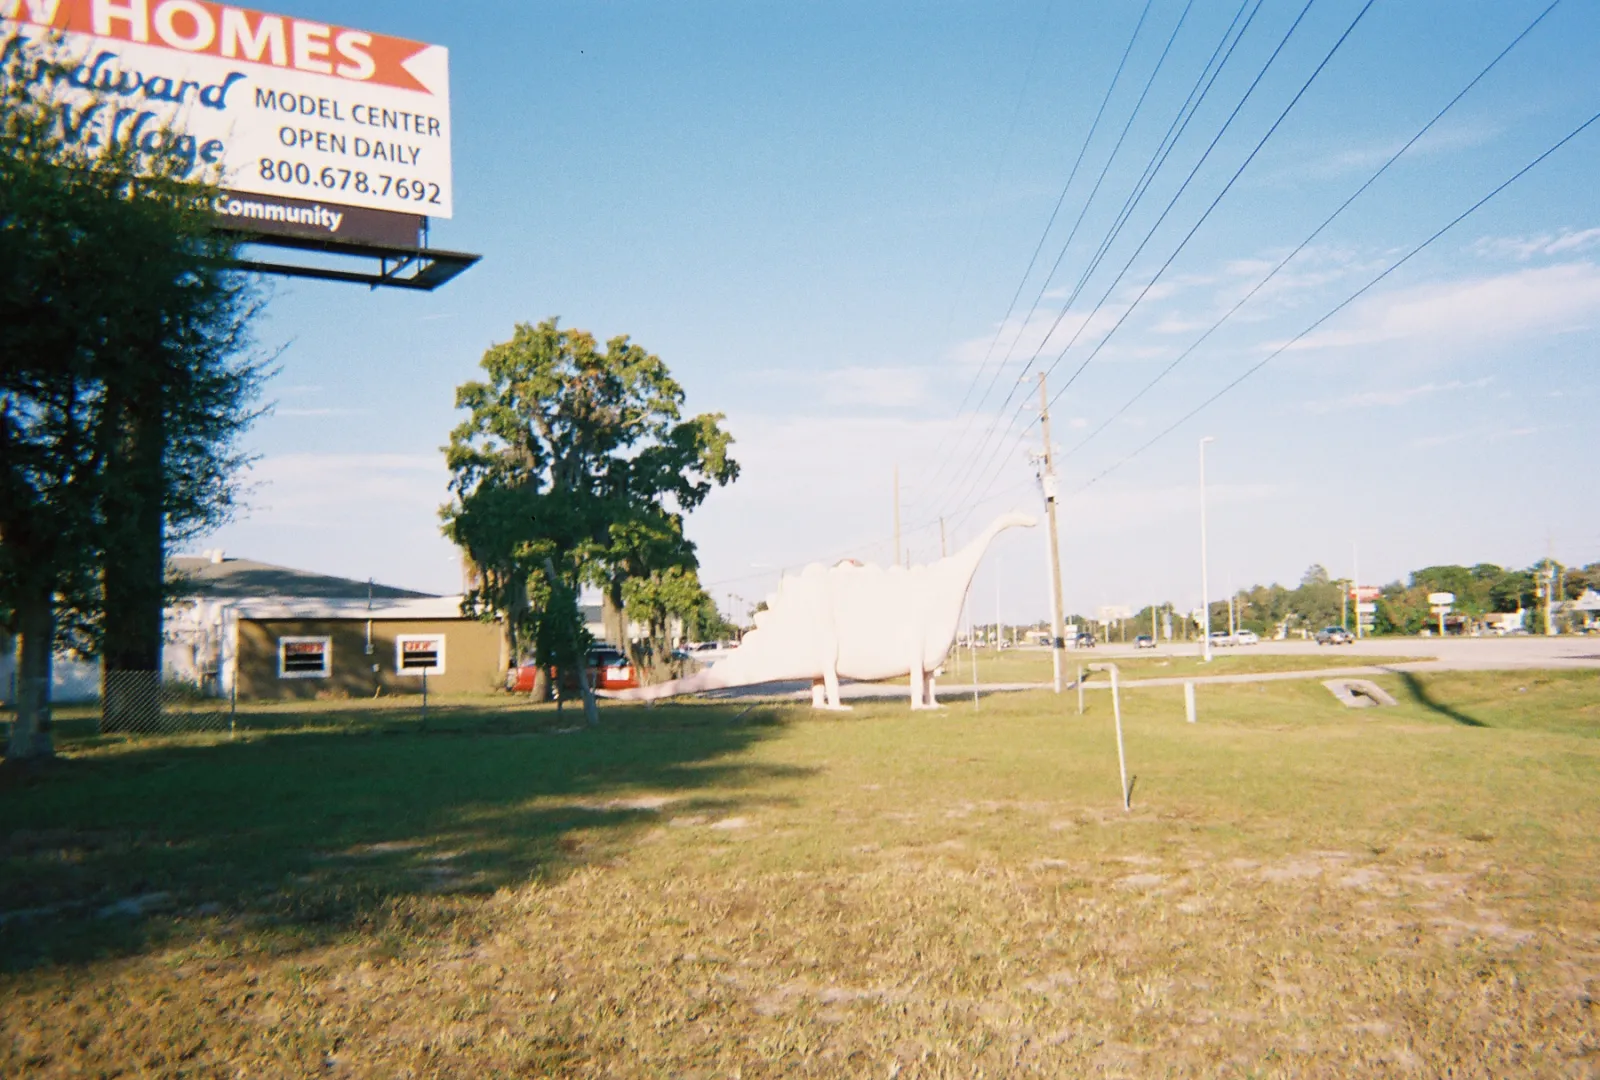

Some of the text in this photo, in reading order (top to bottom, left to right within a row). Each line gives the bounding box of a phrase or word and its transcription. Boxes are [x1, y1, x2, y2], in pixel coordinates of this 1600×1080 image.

[91, 0, 377, 81] HOMES
[255, 87, 441, 137] MODEL CENTER
[279, 126, 421, 166] OPEN DAILY
[259, 157, 442, 205] 800.678.7692
[213, 195, 344, 232] Community
